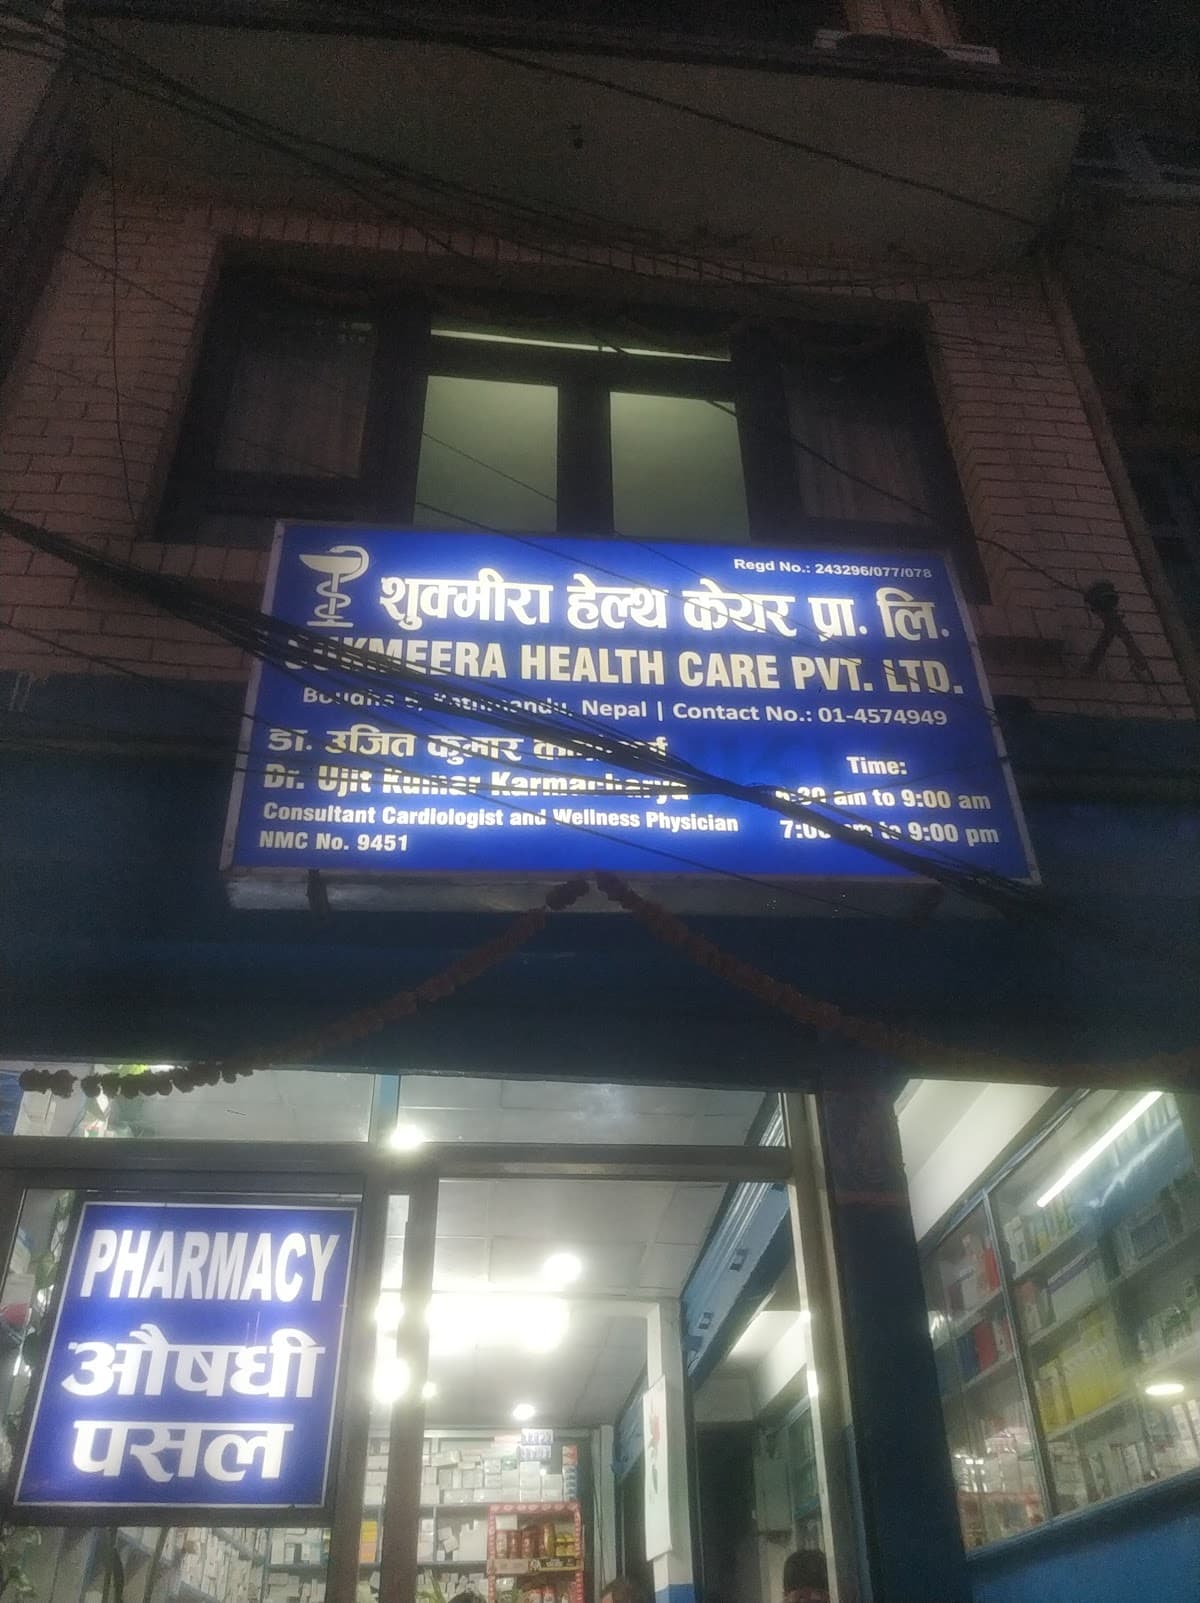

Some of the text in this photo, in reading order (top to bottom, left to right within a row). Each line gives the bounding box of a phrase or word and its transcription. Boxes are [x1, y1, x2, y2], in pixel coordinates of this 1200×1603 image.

[734, 558, 932, 579] Regd No.: 243296/077/078
[566, 573, 669, 631] हेल्थ
[680, 577, 797, 637] केयर
[876, 587, 949, 642] लि.
[285, 635, 965, 695] KMEERA HEALTH CARE PVT. LTD.
[581, 700, 647, 720] Nepal
[672, 704, 762, 722] Contact
[766, 706, 812, 722] No.:
[818, 707, 948, 726] 01-4574949
[325, 724, 417, 758] उजित
[263, 763, 305, 790] Dr.
[318, 765, 373, 797] Ujit
[846, 755, 908, 776] Time:
[833, 789, 867, 807] am
[872, 788, 896, 808] to
[901, 789, 951, 809] 9:00
[958, 794, 992, 810] am
[263, 801, 740, 833] Consultant Cardiologist and Wellness Physician
[259, 830, 409, 852] NMC No. 9451
[908, 821, 959, 843] 9:00
[965, 826, 1000, 847] pm
[79, 1228, 340, 1303] PHARMACY
[71, 1420, 294, 1483] पसल
